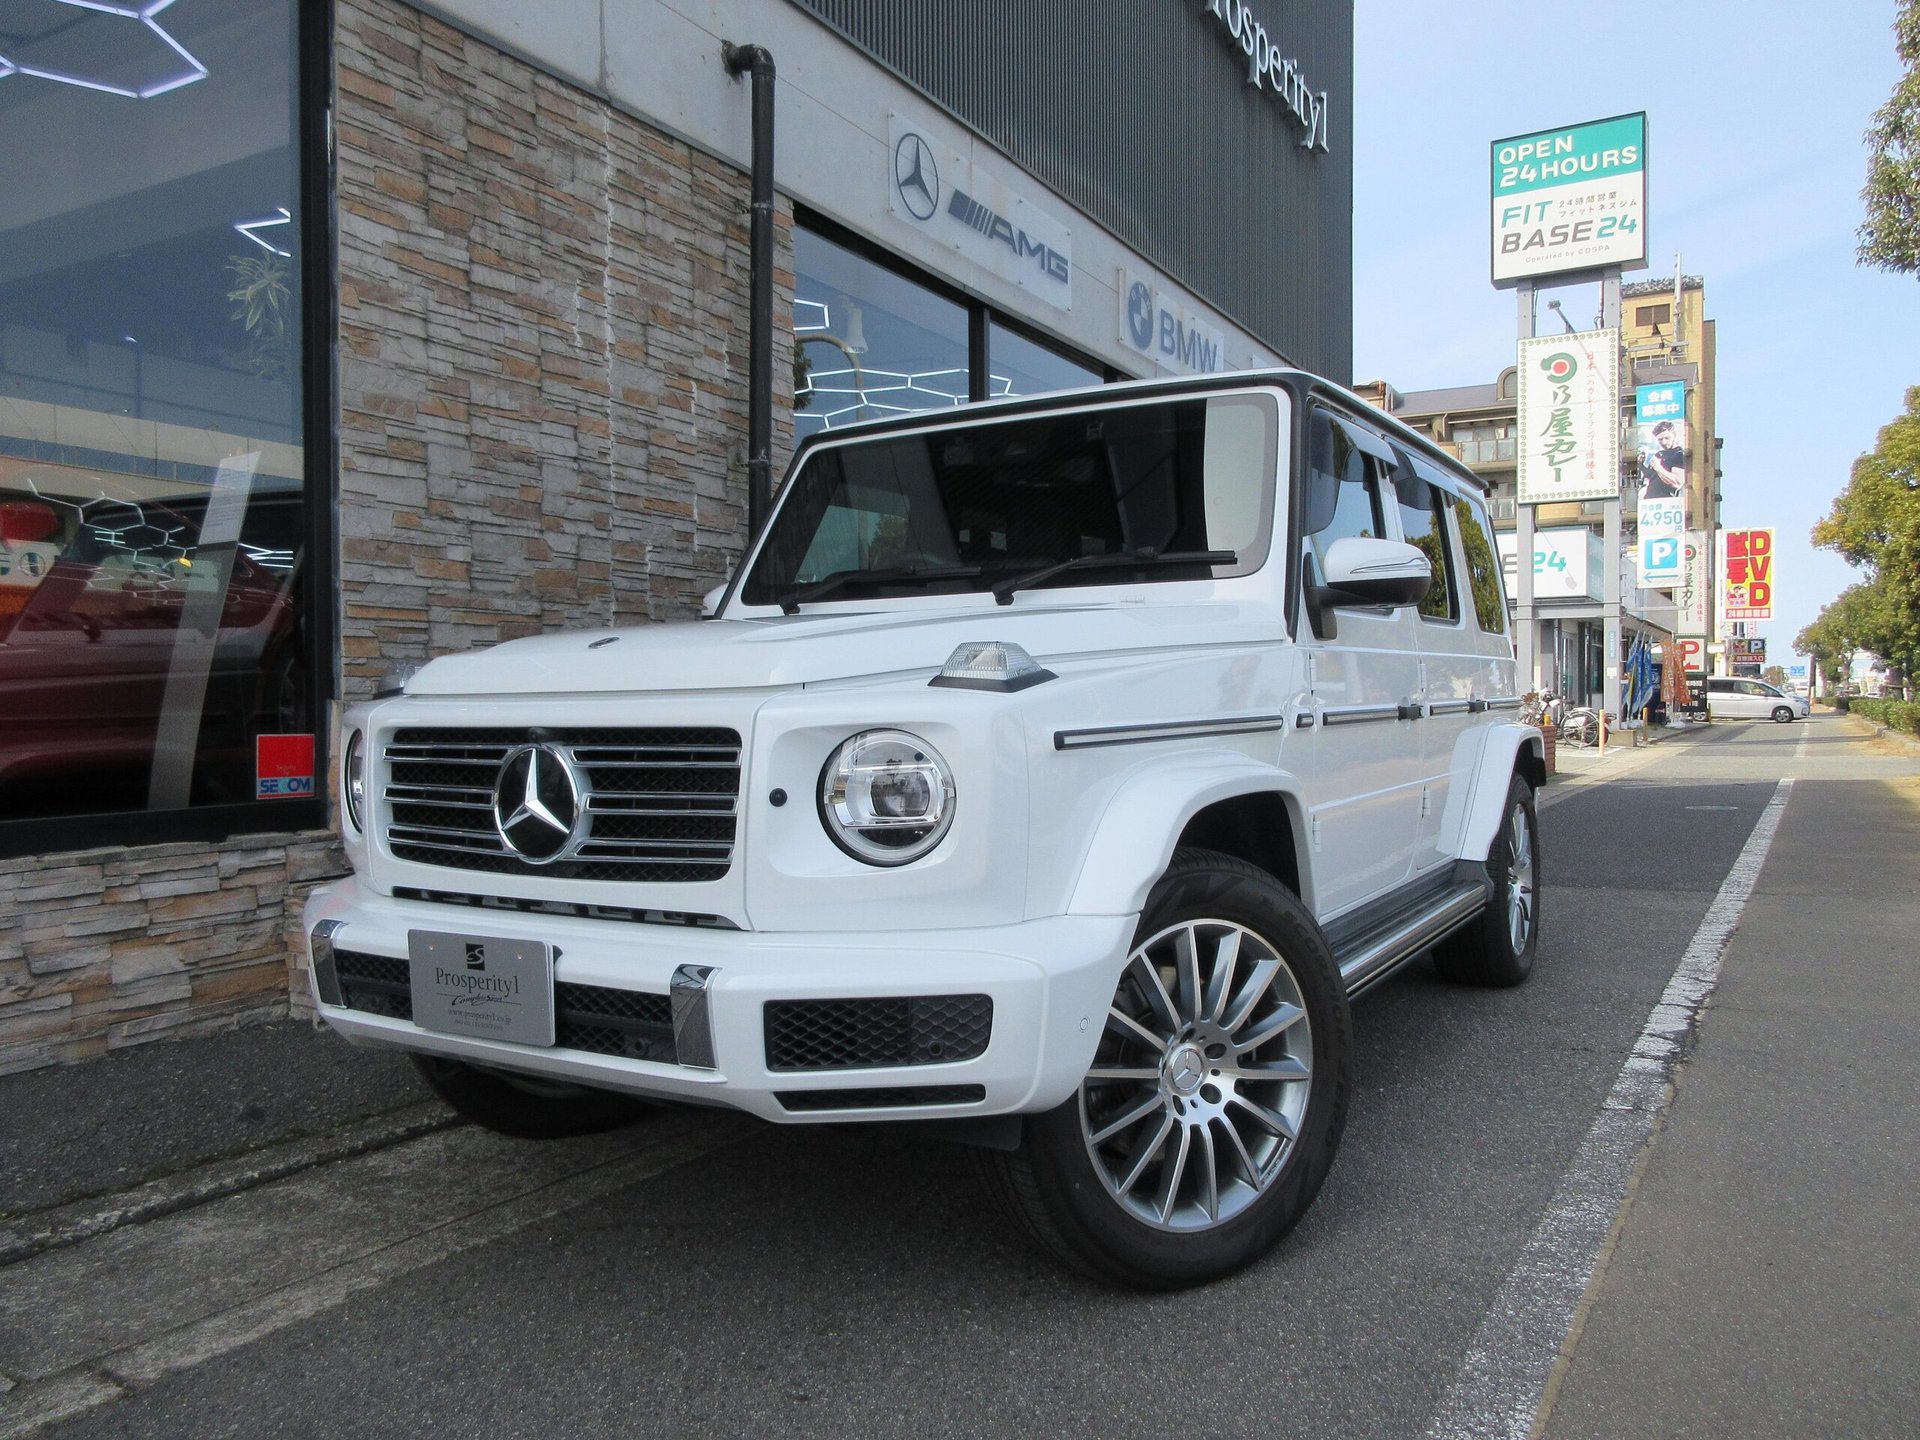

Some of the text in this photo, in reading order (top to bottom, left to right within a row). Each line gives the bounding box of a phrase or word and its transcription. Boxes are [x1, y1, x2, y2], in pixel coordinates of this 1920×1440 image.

[1498, 135, 1574, 166] OPEN
[1500, 200, 1554, 229] FIT
[988, 213, 1069, 285] AMG
[1577, 244, 1610, 255] COSPA
[1159, 308, 1218, 374] BMW
[1639, 510, 1683, 527] 4,950
[1651, 542, 1673, 566] P
[1748, 530, 1772, 607] DVD
[260, 778, 311, 794] SECOM
